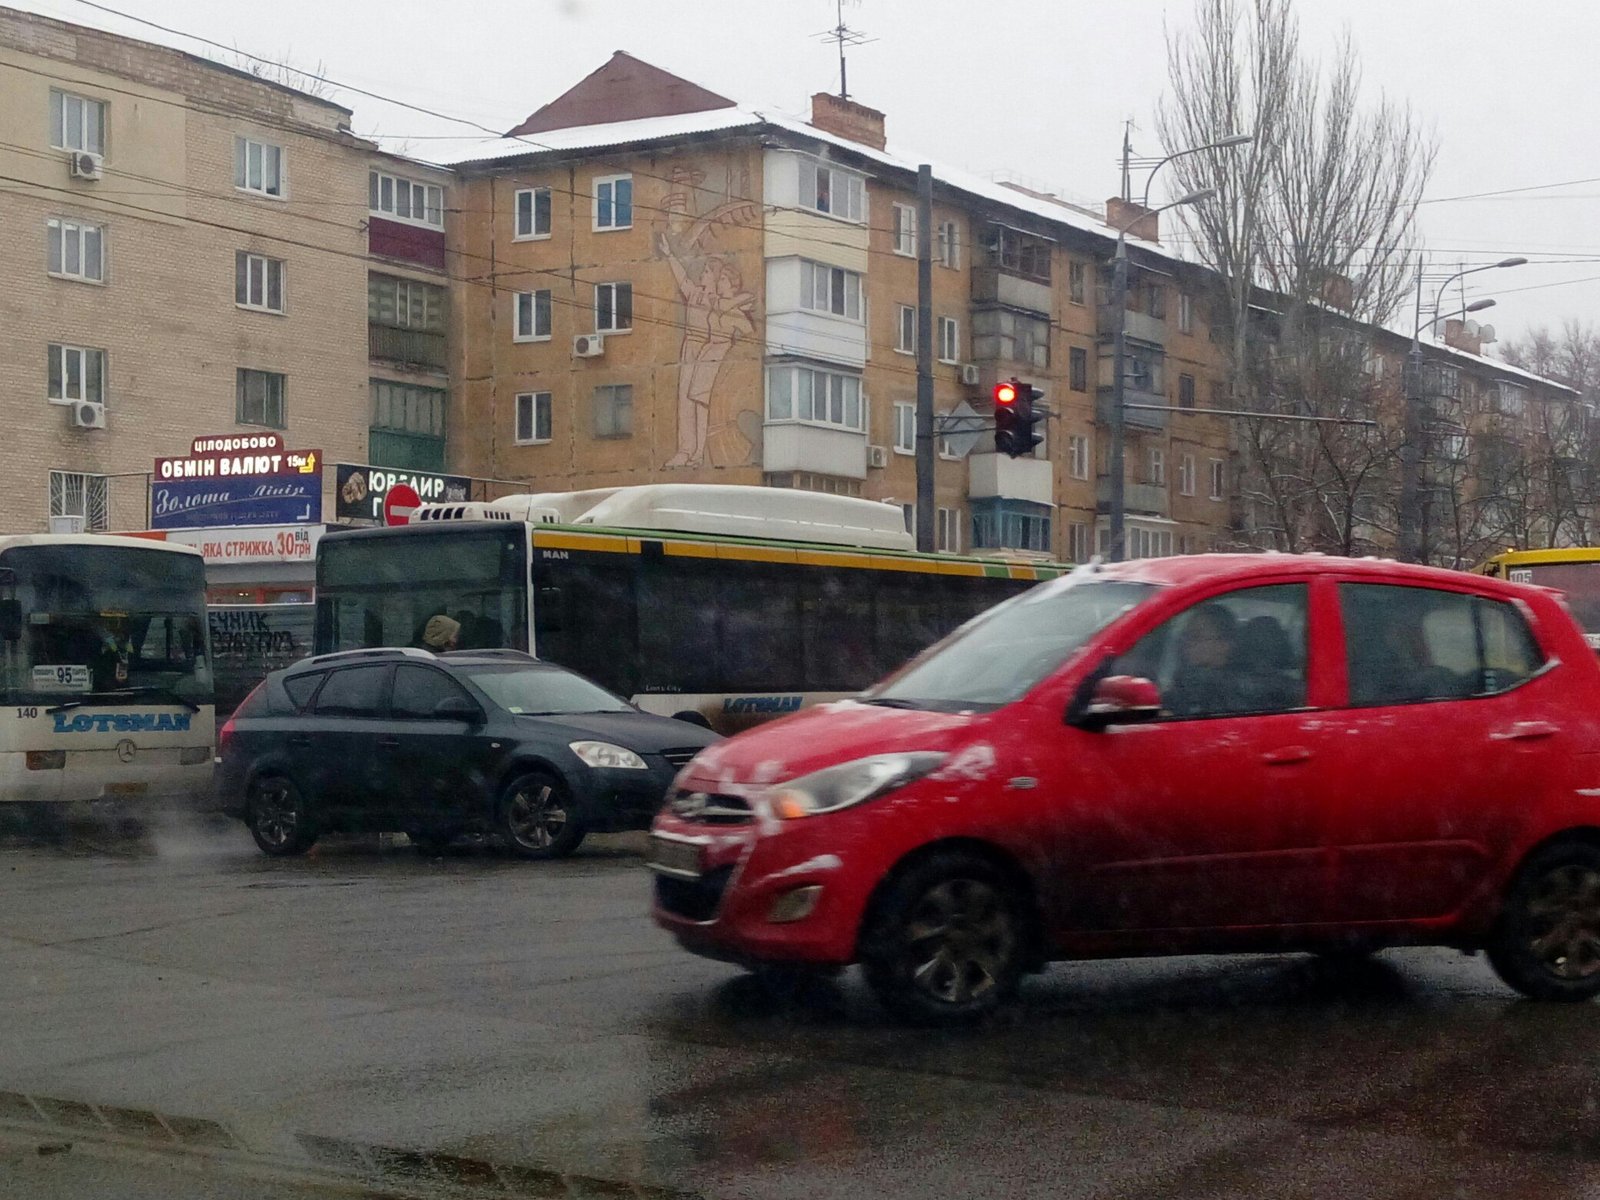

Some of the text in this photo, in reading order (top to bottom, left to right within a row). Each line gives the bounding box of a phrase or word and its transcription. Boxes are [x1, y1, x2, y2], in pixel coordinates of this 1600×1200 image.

[194, 436, 277, 452] ЦІЛОДОБОВО
[161, 459, 215, 478] ОБМІН
[219, 455, 282, 475] ВАЛЮТ
[156, 484, 304, 515] Золота Лінія
[295, 528, 309, 543] від
[225, 541, 274, 557] СТРИЖКА
[277, 532, 295, 556] 30
[295, 543, 311, 558] грн
[543, 550, 569, 559] MAN
[1511, 572, 1531, 584] 105
[57, 666, 72, 684] 95
[17, 707, 38, 719] 140
[53, 713, 192, 733] LOTSMAN
